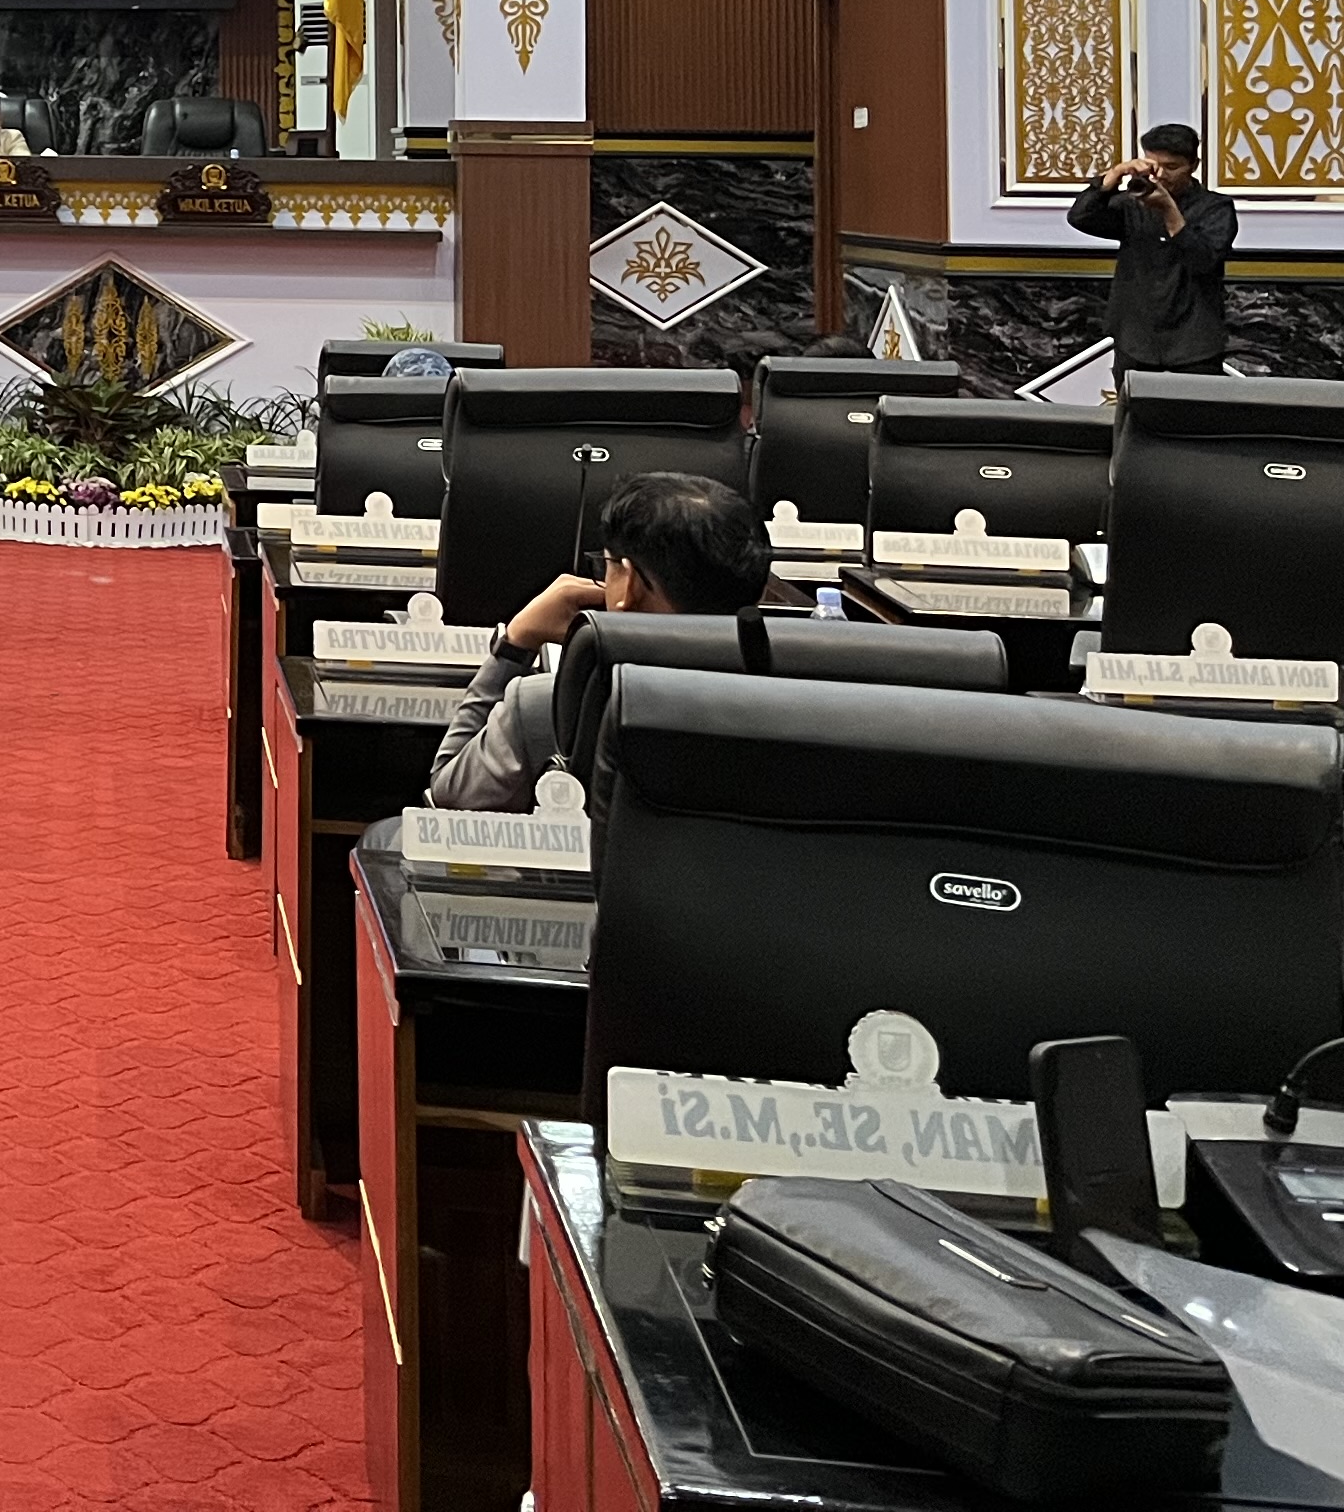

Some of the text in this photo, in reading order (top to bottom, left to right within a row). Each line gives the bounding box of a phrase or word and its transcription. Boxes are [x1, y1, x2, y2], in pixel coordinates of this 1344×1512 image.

[4, 193, 40, 208] KETUA
[177, 198, 252, 213] WAKIL KETUA
[943, 881, 1002, 901] savello
